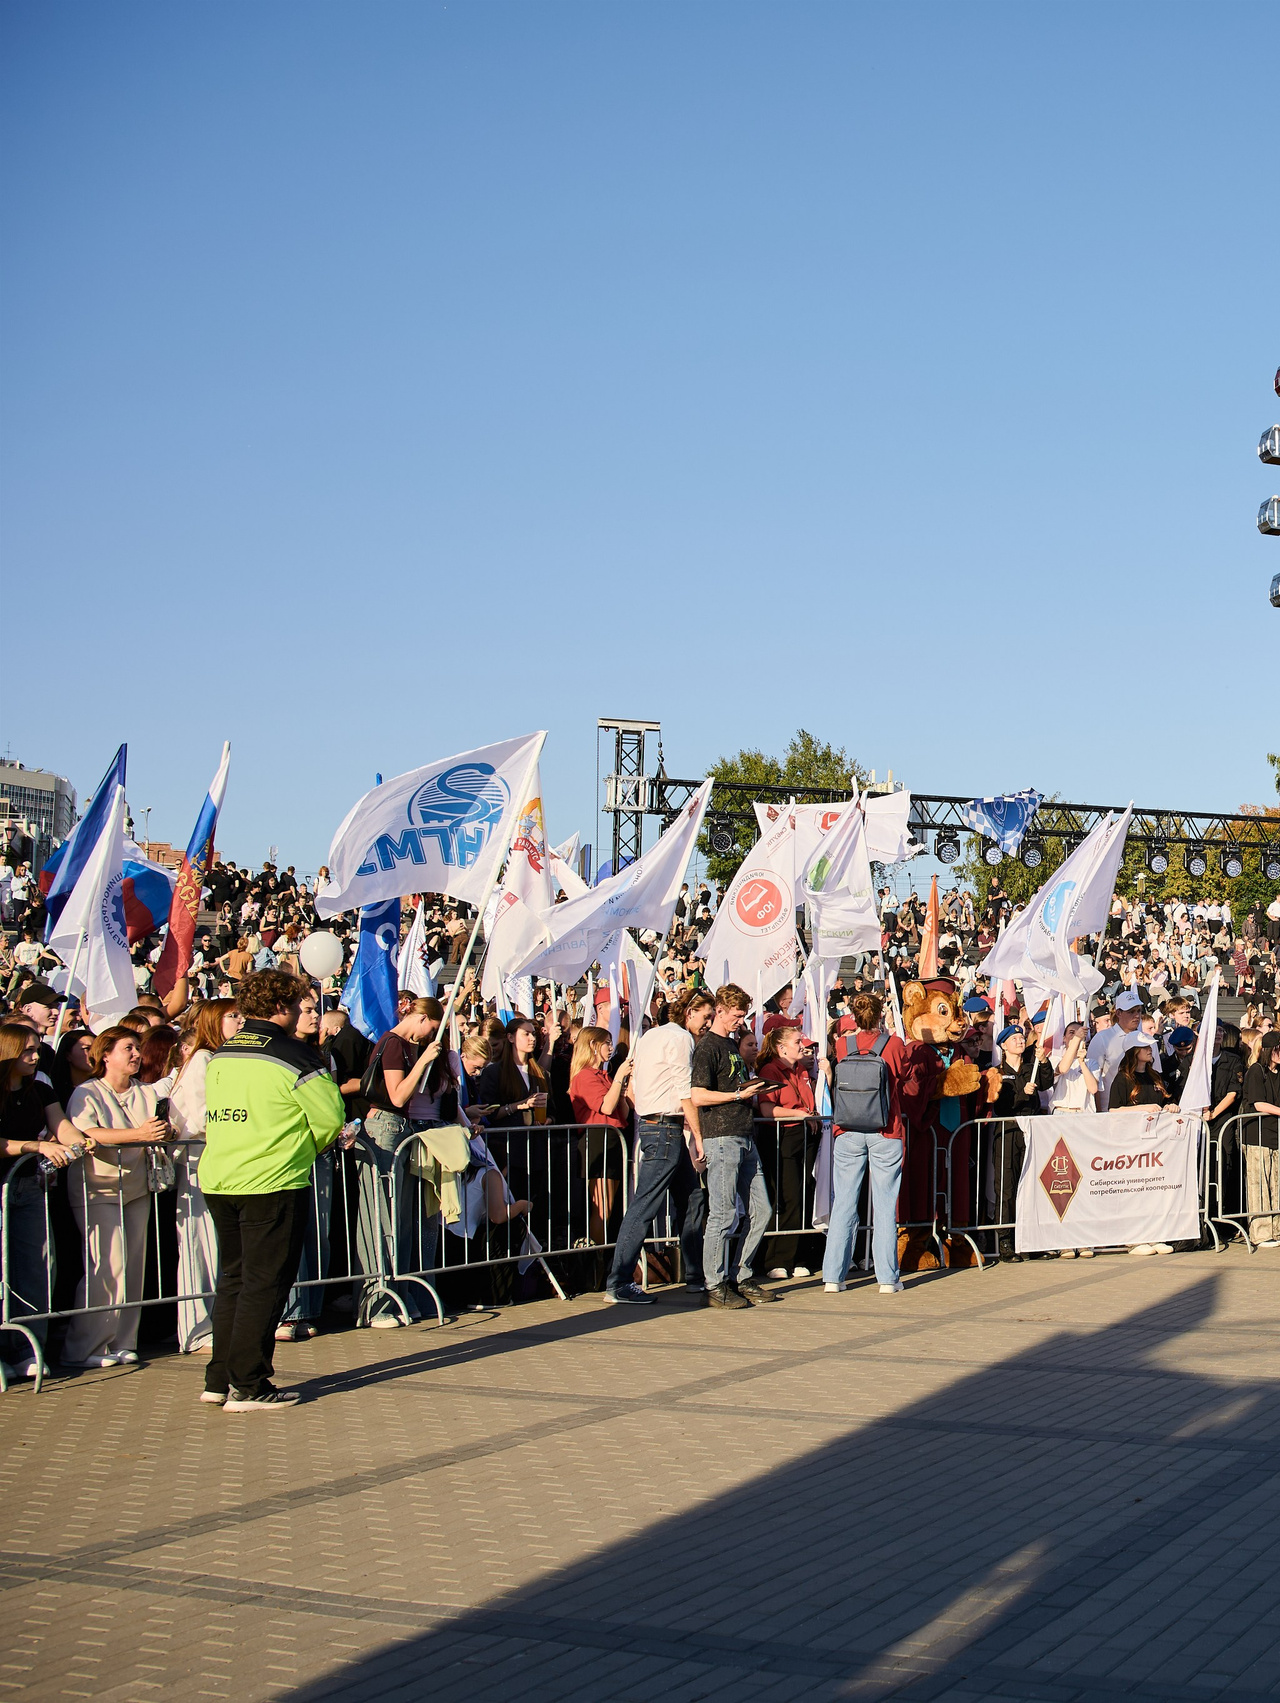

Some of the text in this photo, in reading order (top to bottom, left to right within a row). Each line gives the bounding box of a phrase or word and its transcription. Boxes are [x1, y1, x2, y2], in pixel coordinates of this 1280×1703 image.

[1090, 1151, 1164, 1172] СибУПК
[1089, 1176, 1166, 1188] Сибирский университет
[1089, 1184, 1183, 1196] потребительской кооперации
